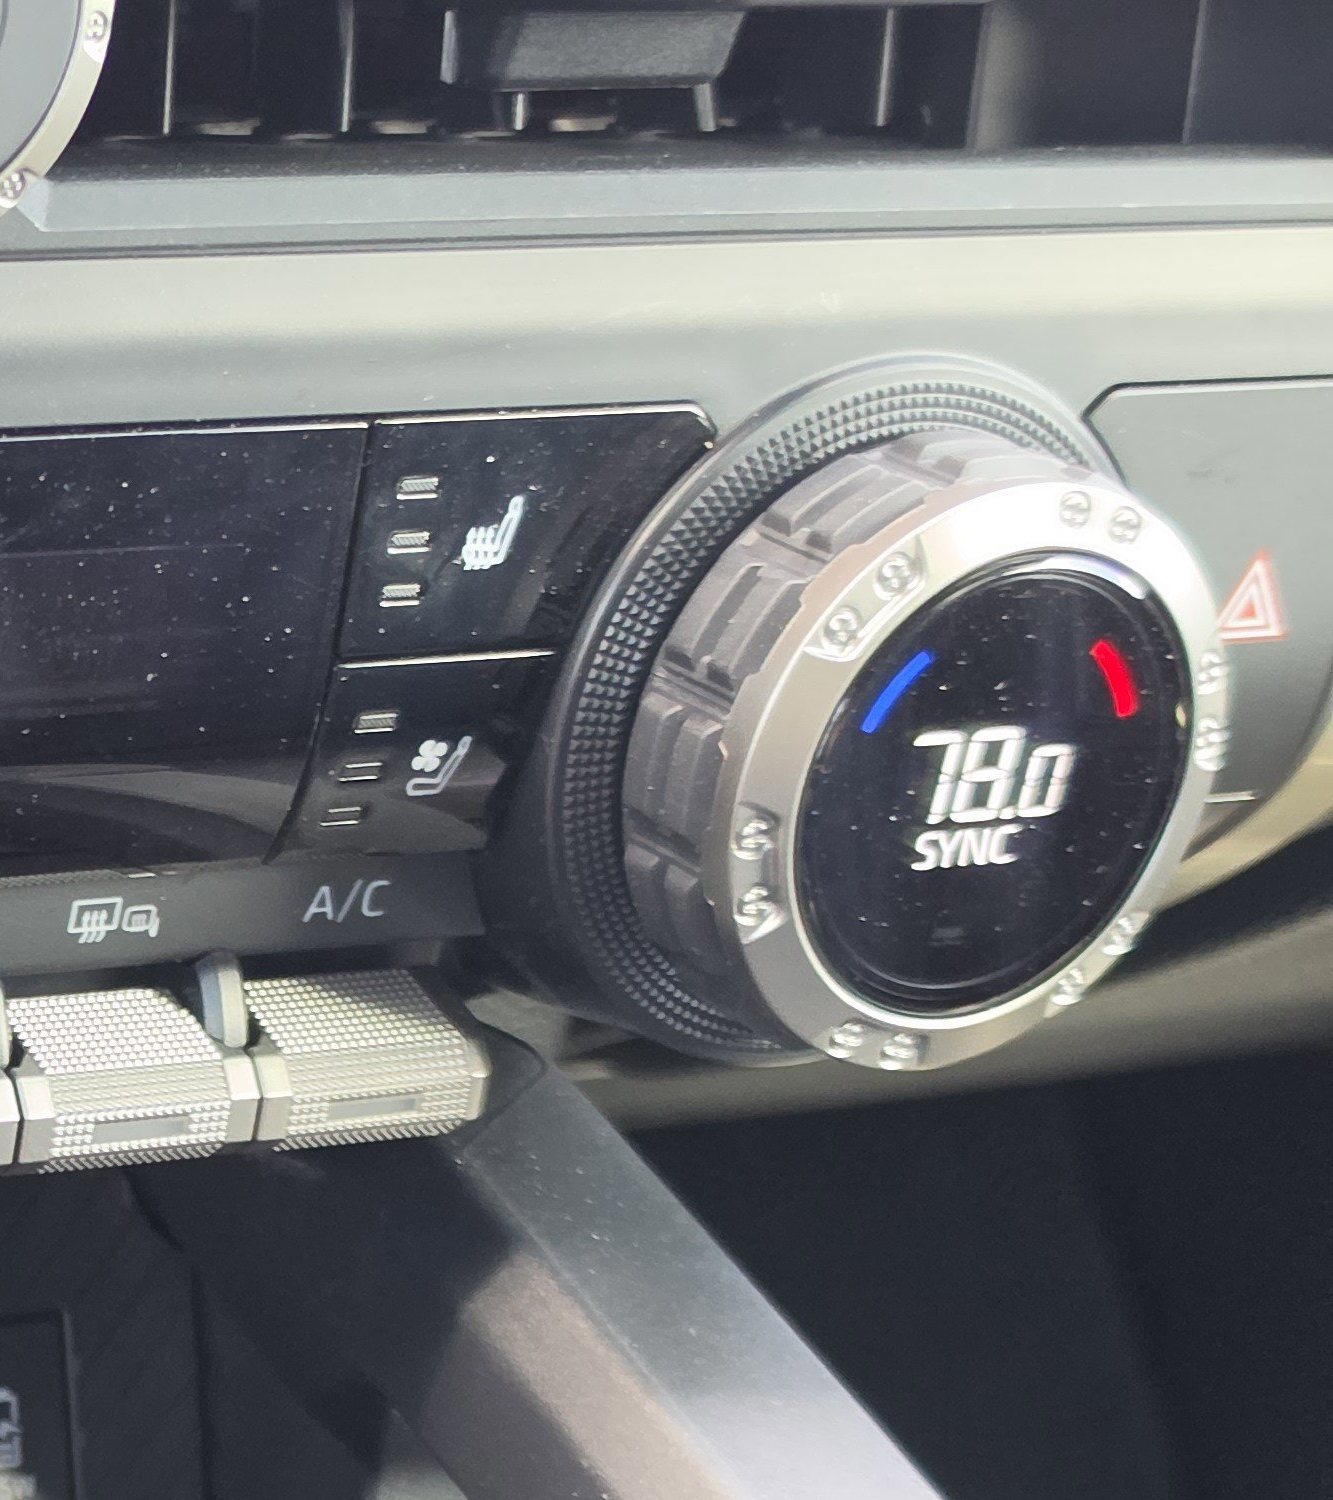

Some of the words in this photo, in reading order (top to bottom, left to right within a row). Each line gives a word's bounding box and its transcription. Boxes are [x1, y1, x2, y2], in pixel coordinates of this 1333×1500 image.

[912, 724, 1076, 824] 78.0
[910, 824, 1023, 872] SYNC
[301, 879, 392, 924] A/C
